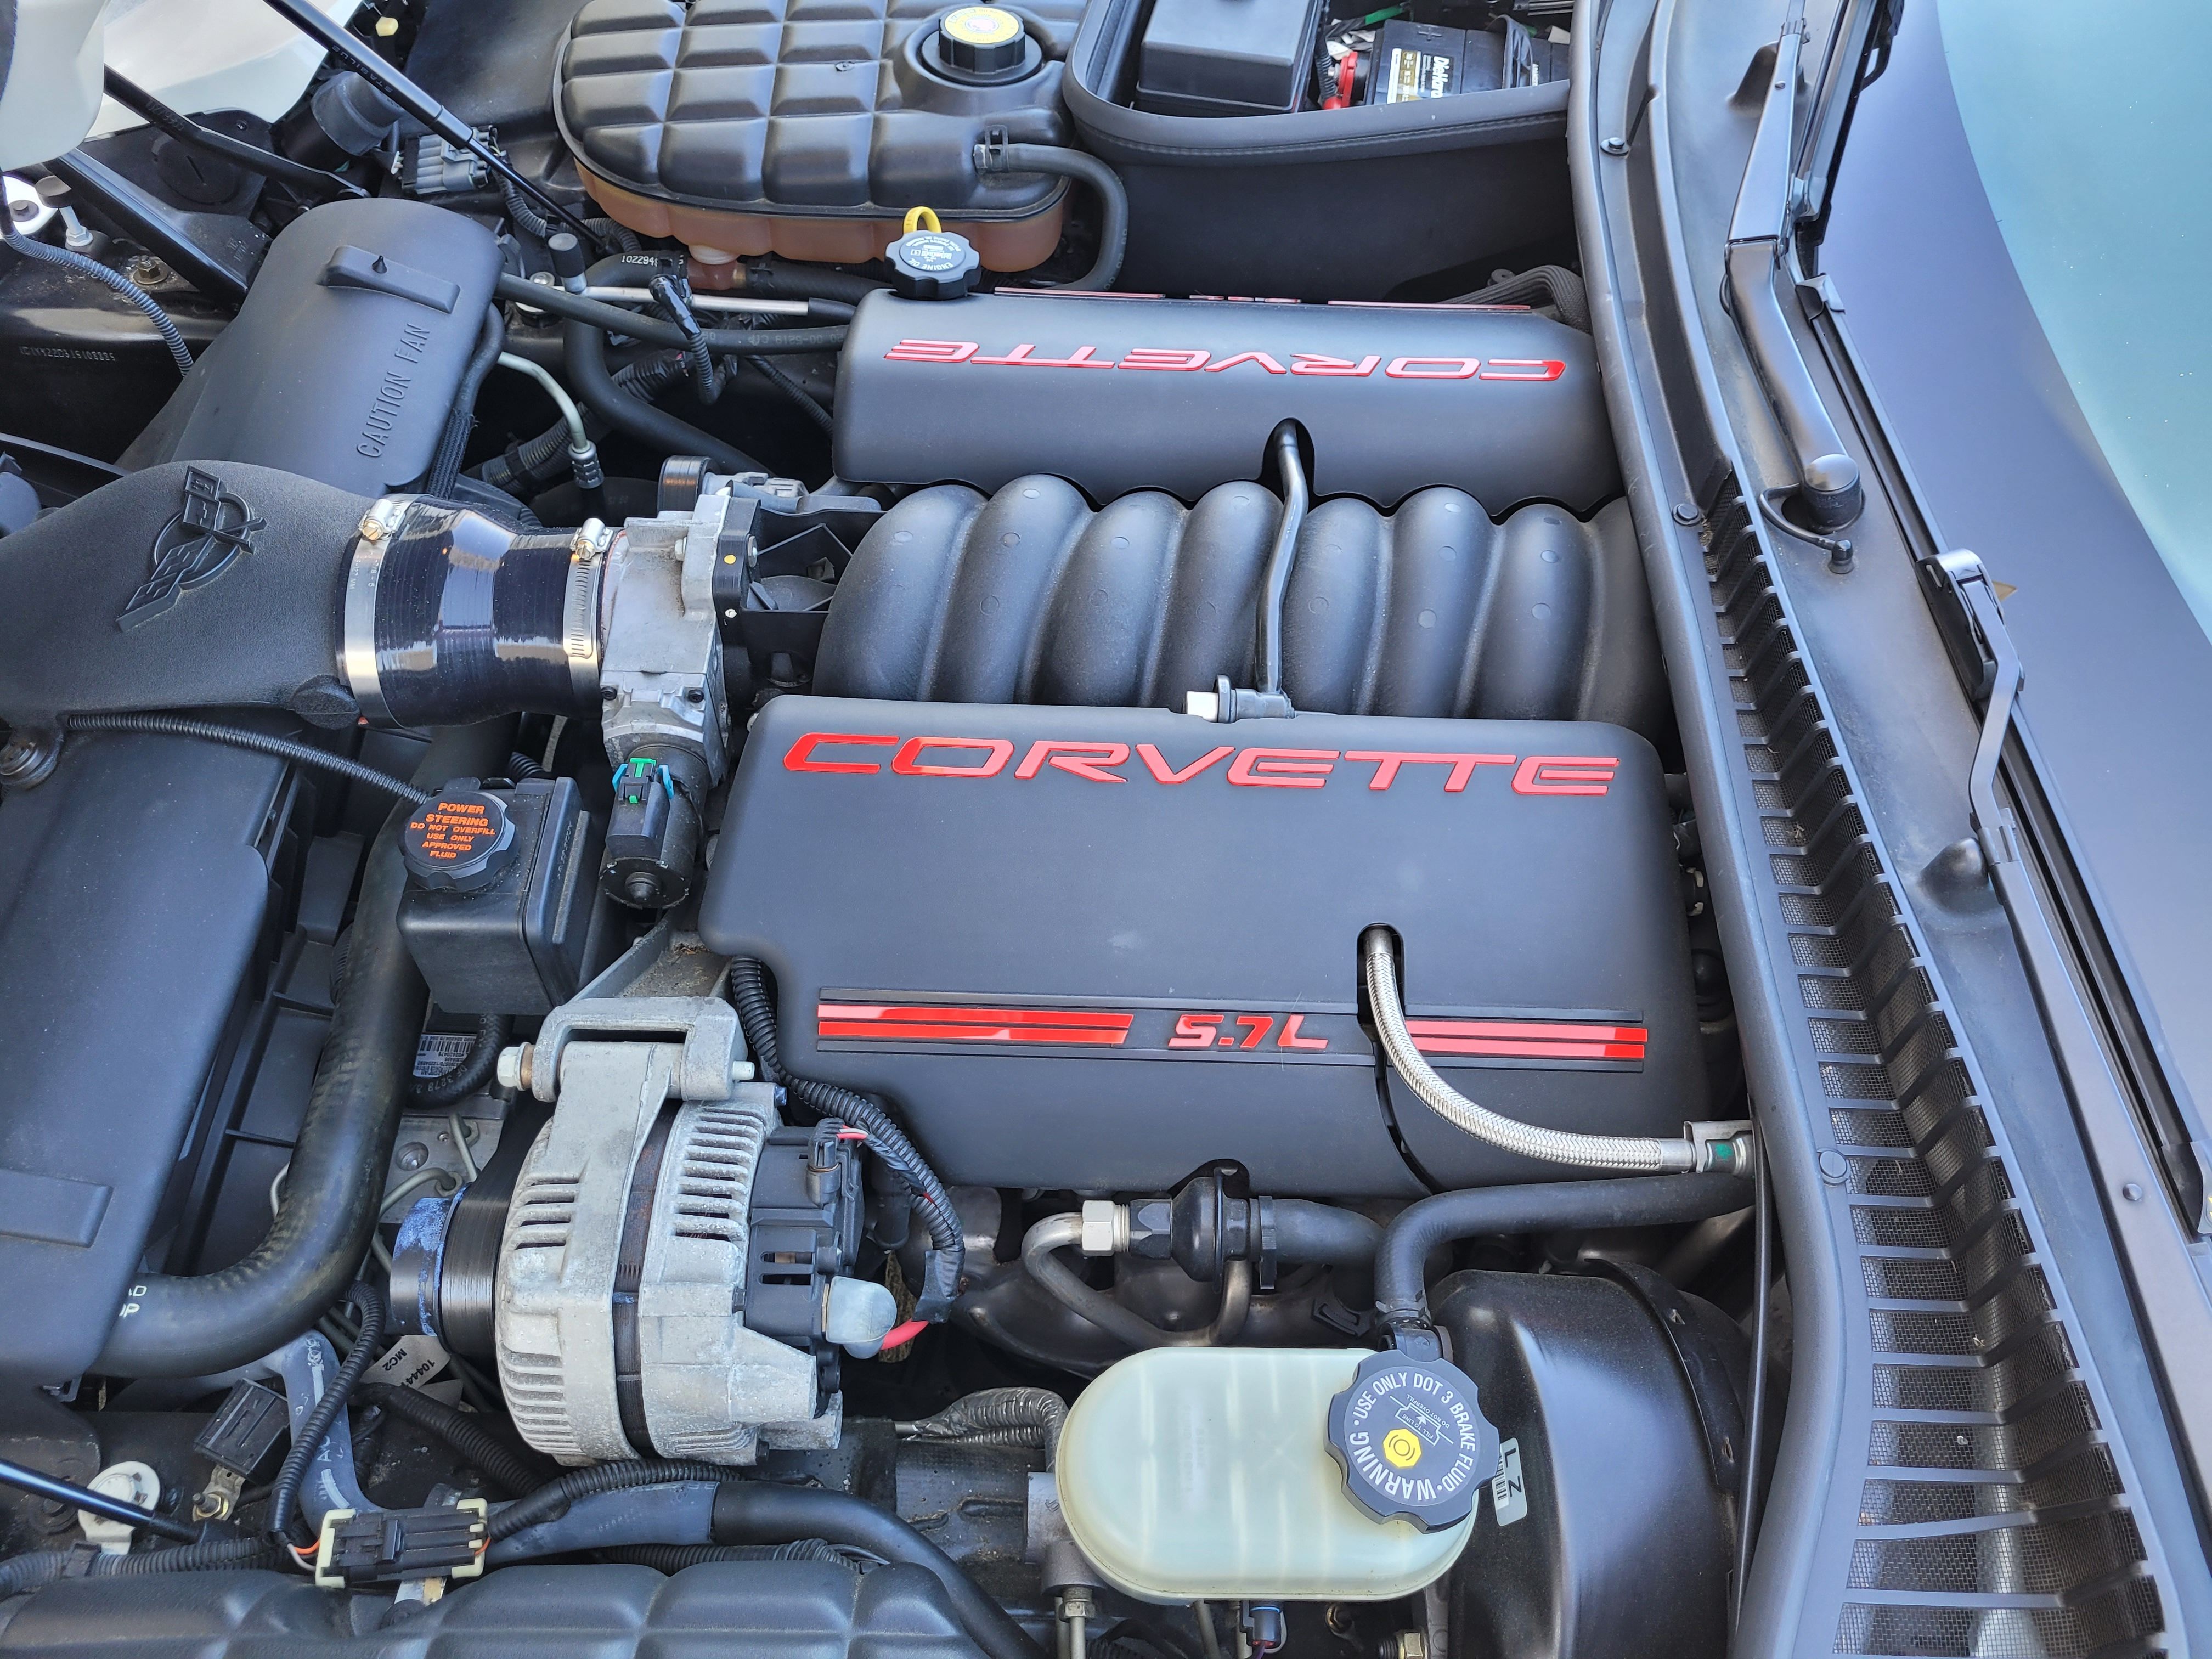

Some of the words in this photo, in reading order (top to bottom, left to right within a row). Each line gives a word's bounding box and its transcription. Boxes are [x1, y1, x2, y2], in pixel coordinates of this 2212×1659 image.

[331, 45, 393, 93] STABILUS
[908, 258, 920, 267] OIL
[921, 262, 953, 270] ENGINE
[883, 338, 1567, 382] CORVETTE
[357, 371, 411, 458] CAUTION
[394, 323, 430, 363] FAN
[782, 731, 1621, 797] CORVETTE
[438, 802, 486, 815] POWER
[410, 822, 426, 830] DO
[453, 826, 496, 835] OVERFILL
[425, 813, 489, 827] STEERING
[422, 841, 473, 851] APPROVED
[430, 850, 458, 859] FLUID
[1168, 1014, 1328, 1049] 5.7L
[427, 1075, 454, 1092] 3278
[382, 1348, 408, 1371] MC2
[1372, 1372, 1407, 1396] ONLY
[1413, 1373, 1444, 1396] DOT
[1352, 1390, 1378, 1420] USE
[1406, 1393, 1430, 1414] OVERFILL
[1441, 1390, 1454, 1404] 3
[1402, 1413, 1414, 1424] LINE
[1414, 1421, 1423, 1430] TO
[1431, 1412, 1442, 1423] NOT
[1441, 1420, 1451, 1429] DO
[1421, 1429, 1435, 1440] FILL
[1449, 1401, 1476, 1452] BRAKE
[1350, 1431, 1437, 1502] WARNING
[1441, 1453, 1474, 1492] FLUID
